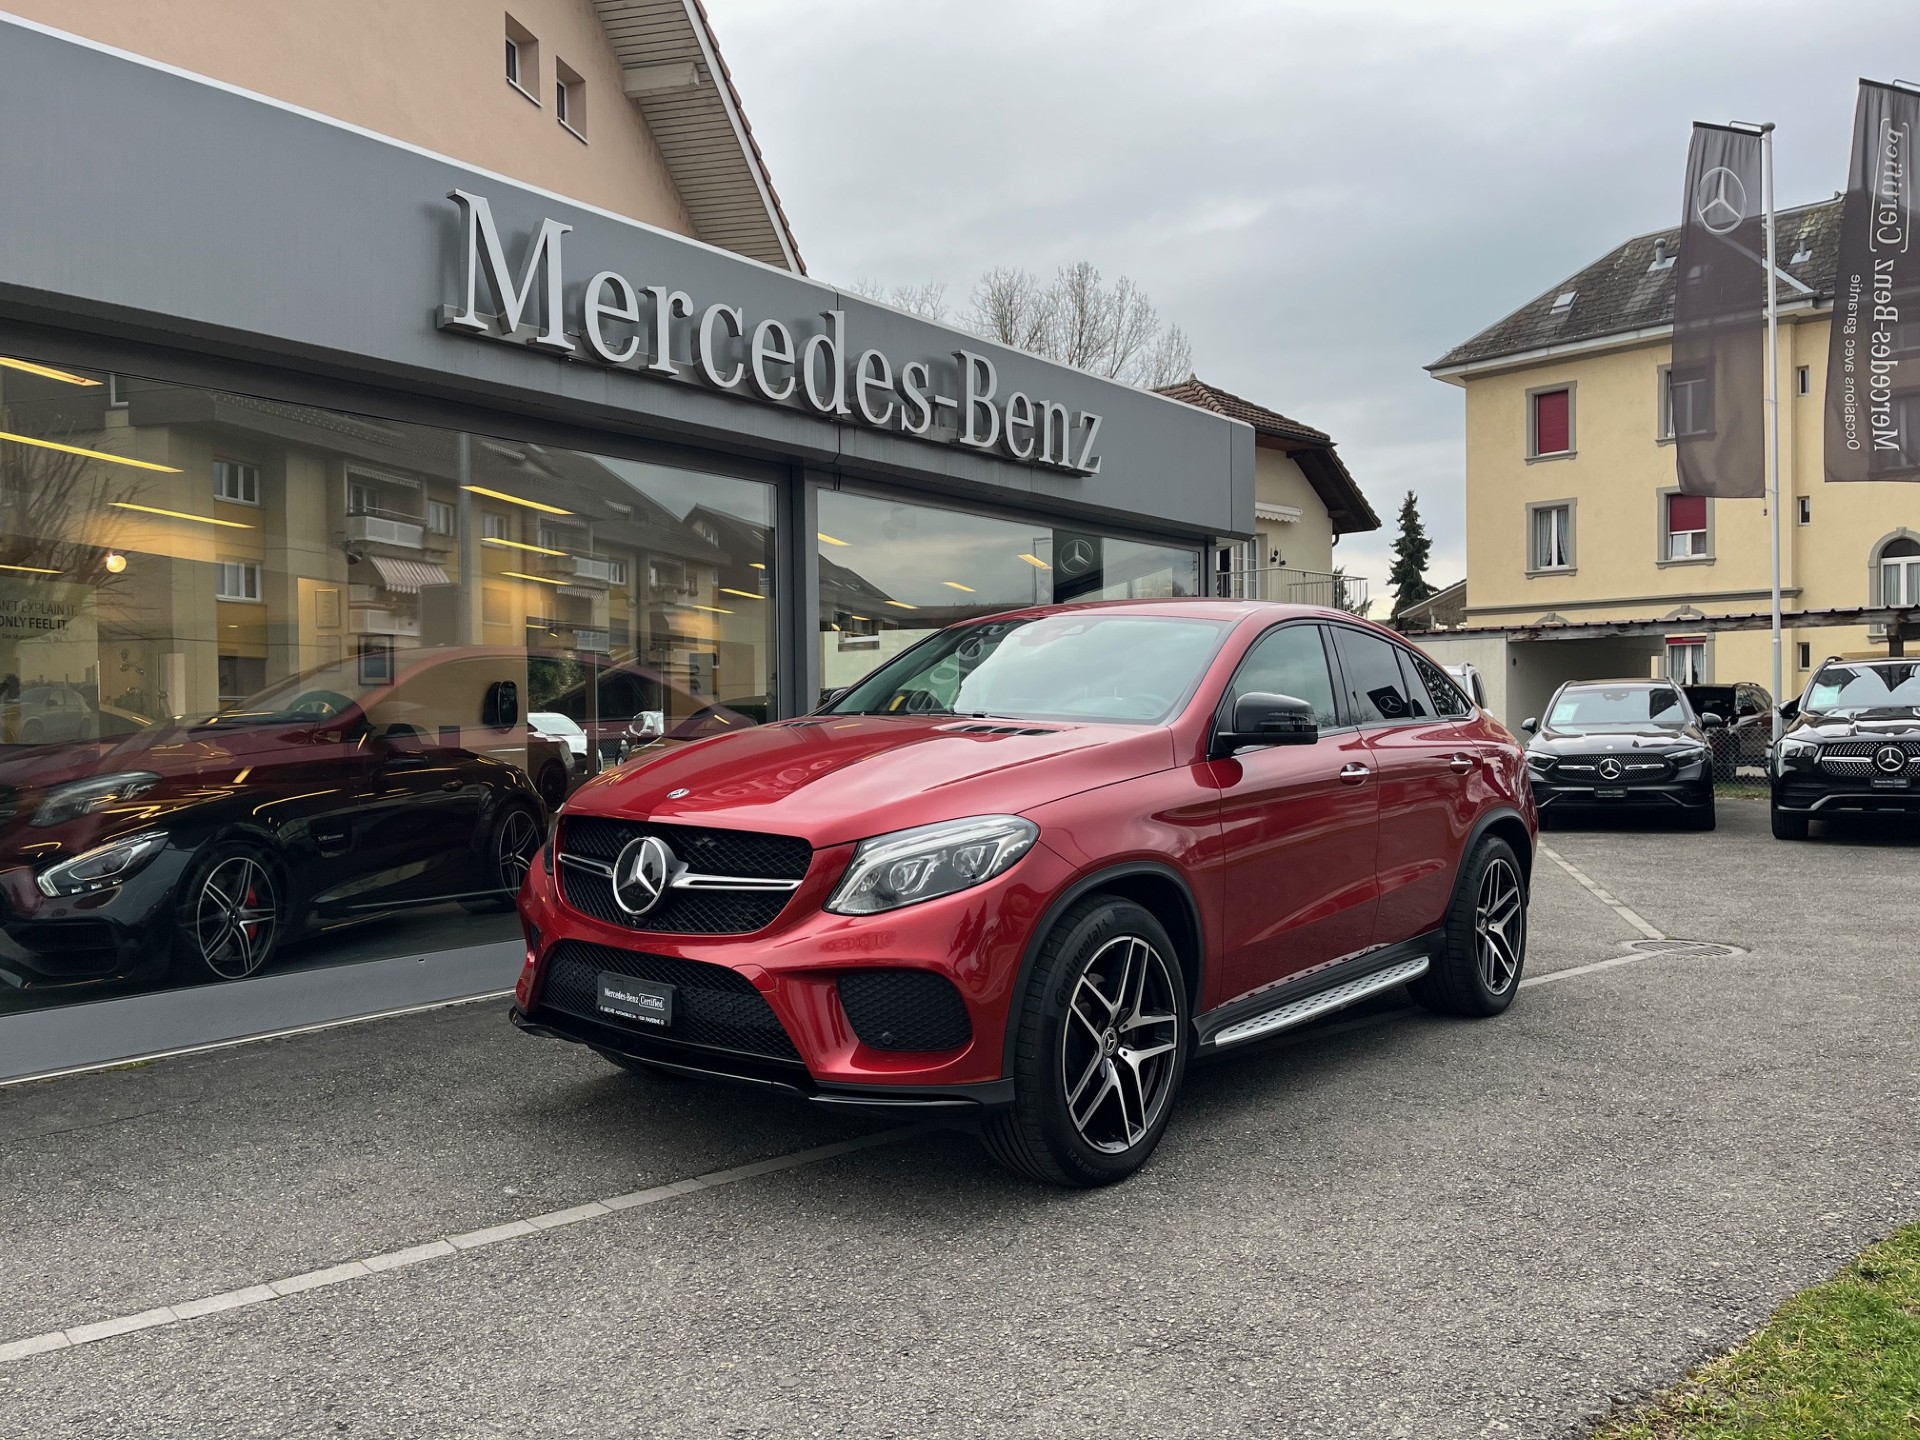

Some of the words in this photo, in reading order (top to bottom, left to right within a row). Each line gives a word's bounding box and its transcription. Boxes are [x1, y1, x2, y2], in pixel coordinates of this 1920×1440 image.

[445, 188, 1103, 476] Mercedes-Benz
[21, 601, 65, 615] EXPLAIN
[29, 617, 55, 630] FEEL
[604, 987, 639, 1004] Mercedes-Benz
[640, 995, 663, 1009] Certified
